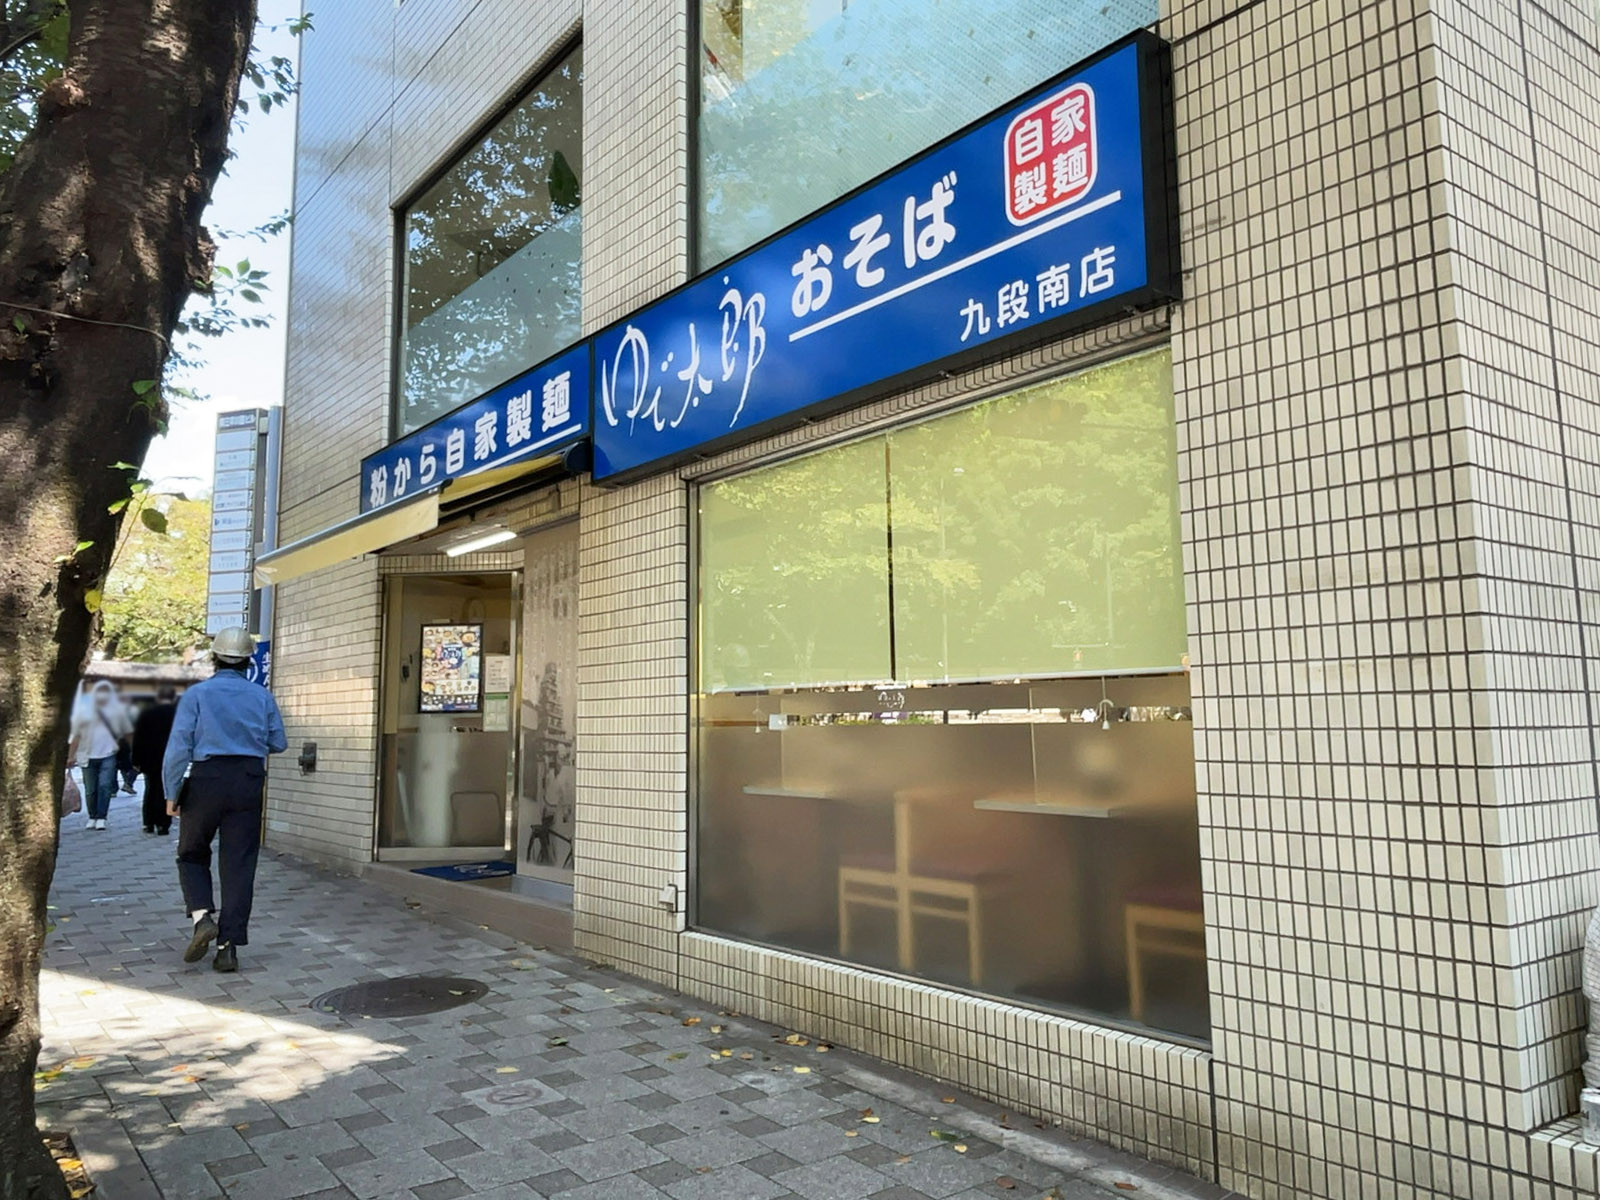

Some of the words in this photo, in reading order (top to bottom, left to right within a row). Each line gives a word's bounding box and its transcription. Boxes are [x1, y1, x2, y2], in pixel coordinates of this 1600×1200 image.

[1014, 94, 1086, 164] 自家
[791, 171, 957, 318] おそば
[959, 245, 1116, 342] 九段南店
[602, 276, 766, 435] ゆで太郎
[369, 370, 571, 508] 粉から自家製麺
